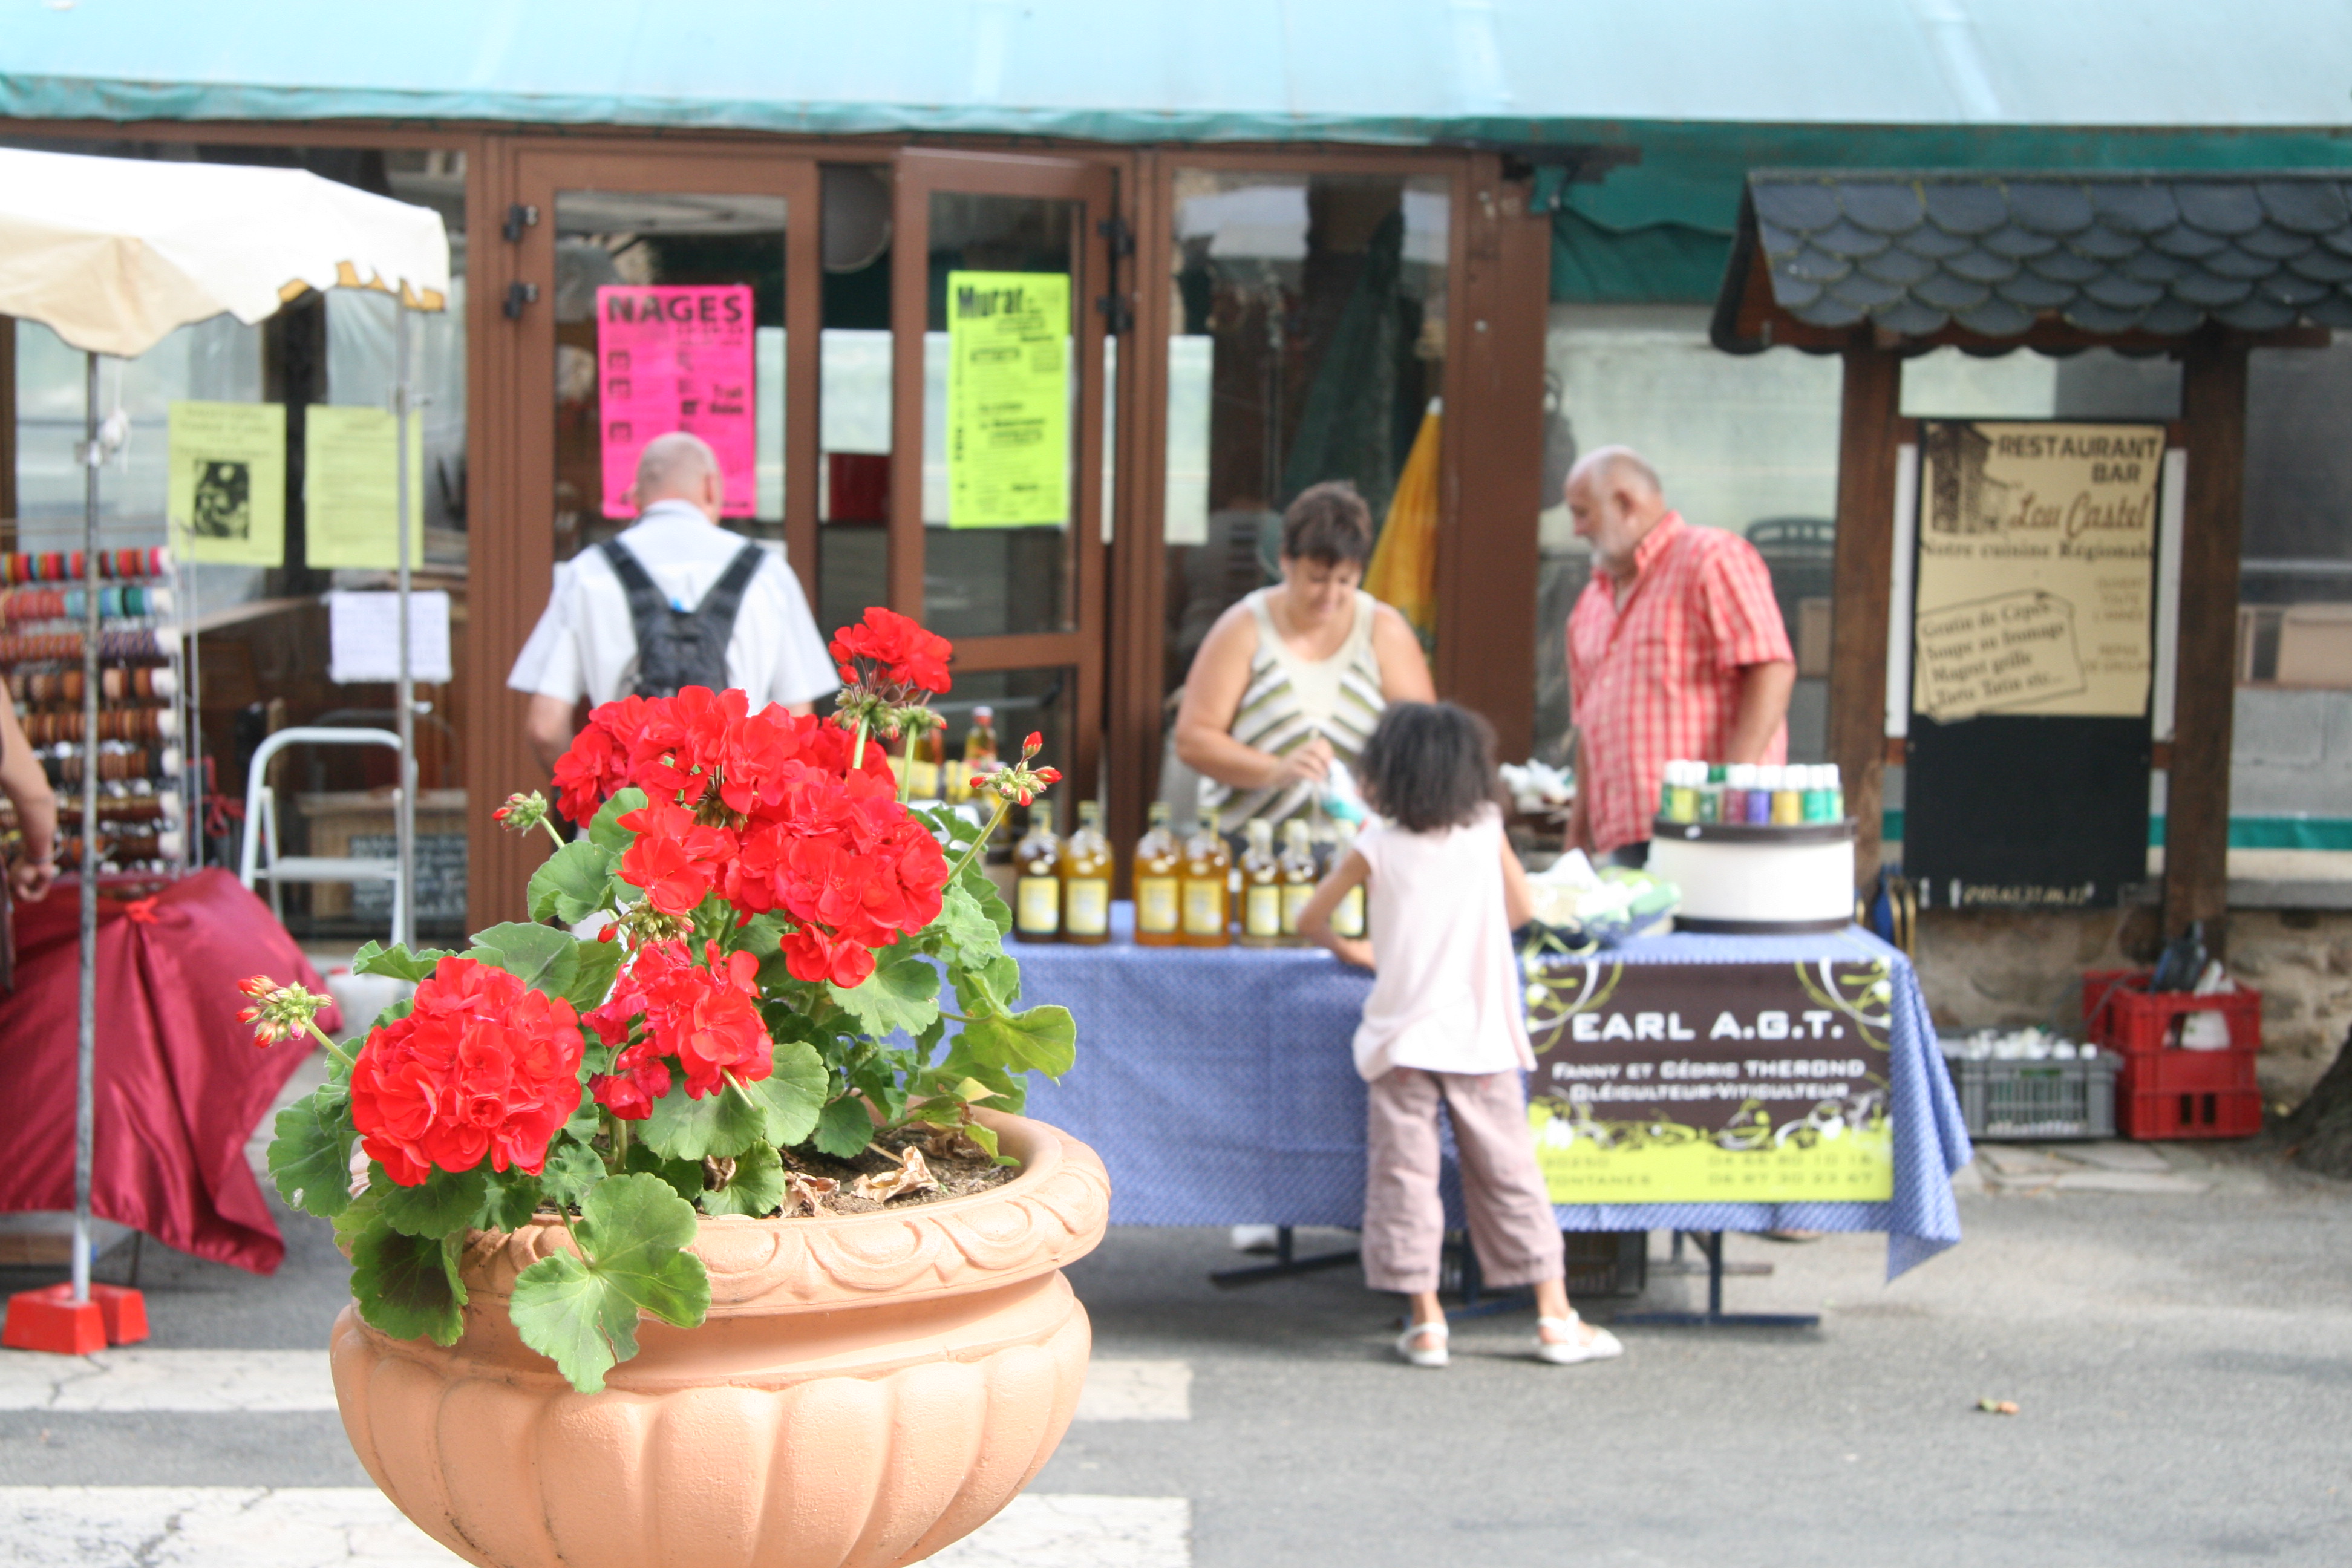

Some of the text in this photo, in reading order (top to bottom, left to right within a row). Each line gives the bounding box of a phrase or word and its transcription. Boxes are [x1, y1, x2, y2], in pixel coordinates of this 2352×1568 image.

[607, 295, 743, 322] NAGES
[1998, 434, 2158, 459] RESTAURANT
[2091, 463, 2141, 483] BAR
[2008, 489, 2150, 539] Lou Castel
[1573, 1011, 1844, 1041] EARL A.G.T.
[1744, 1059, 1866, 1079] THEROND
